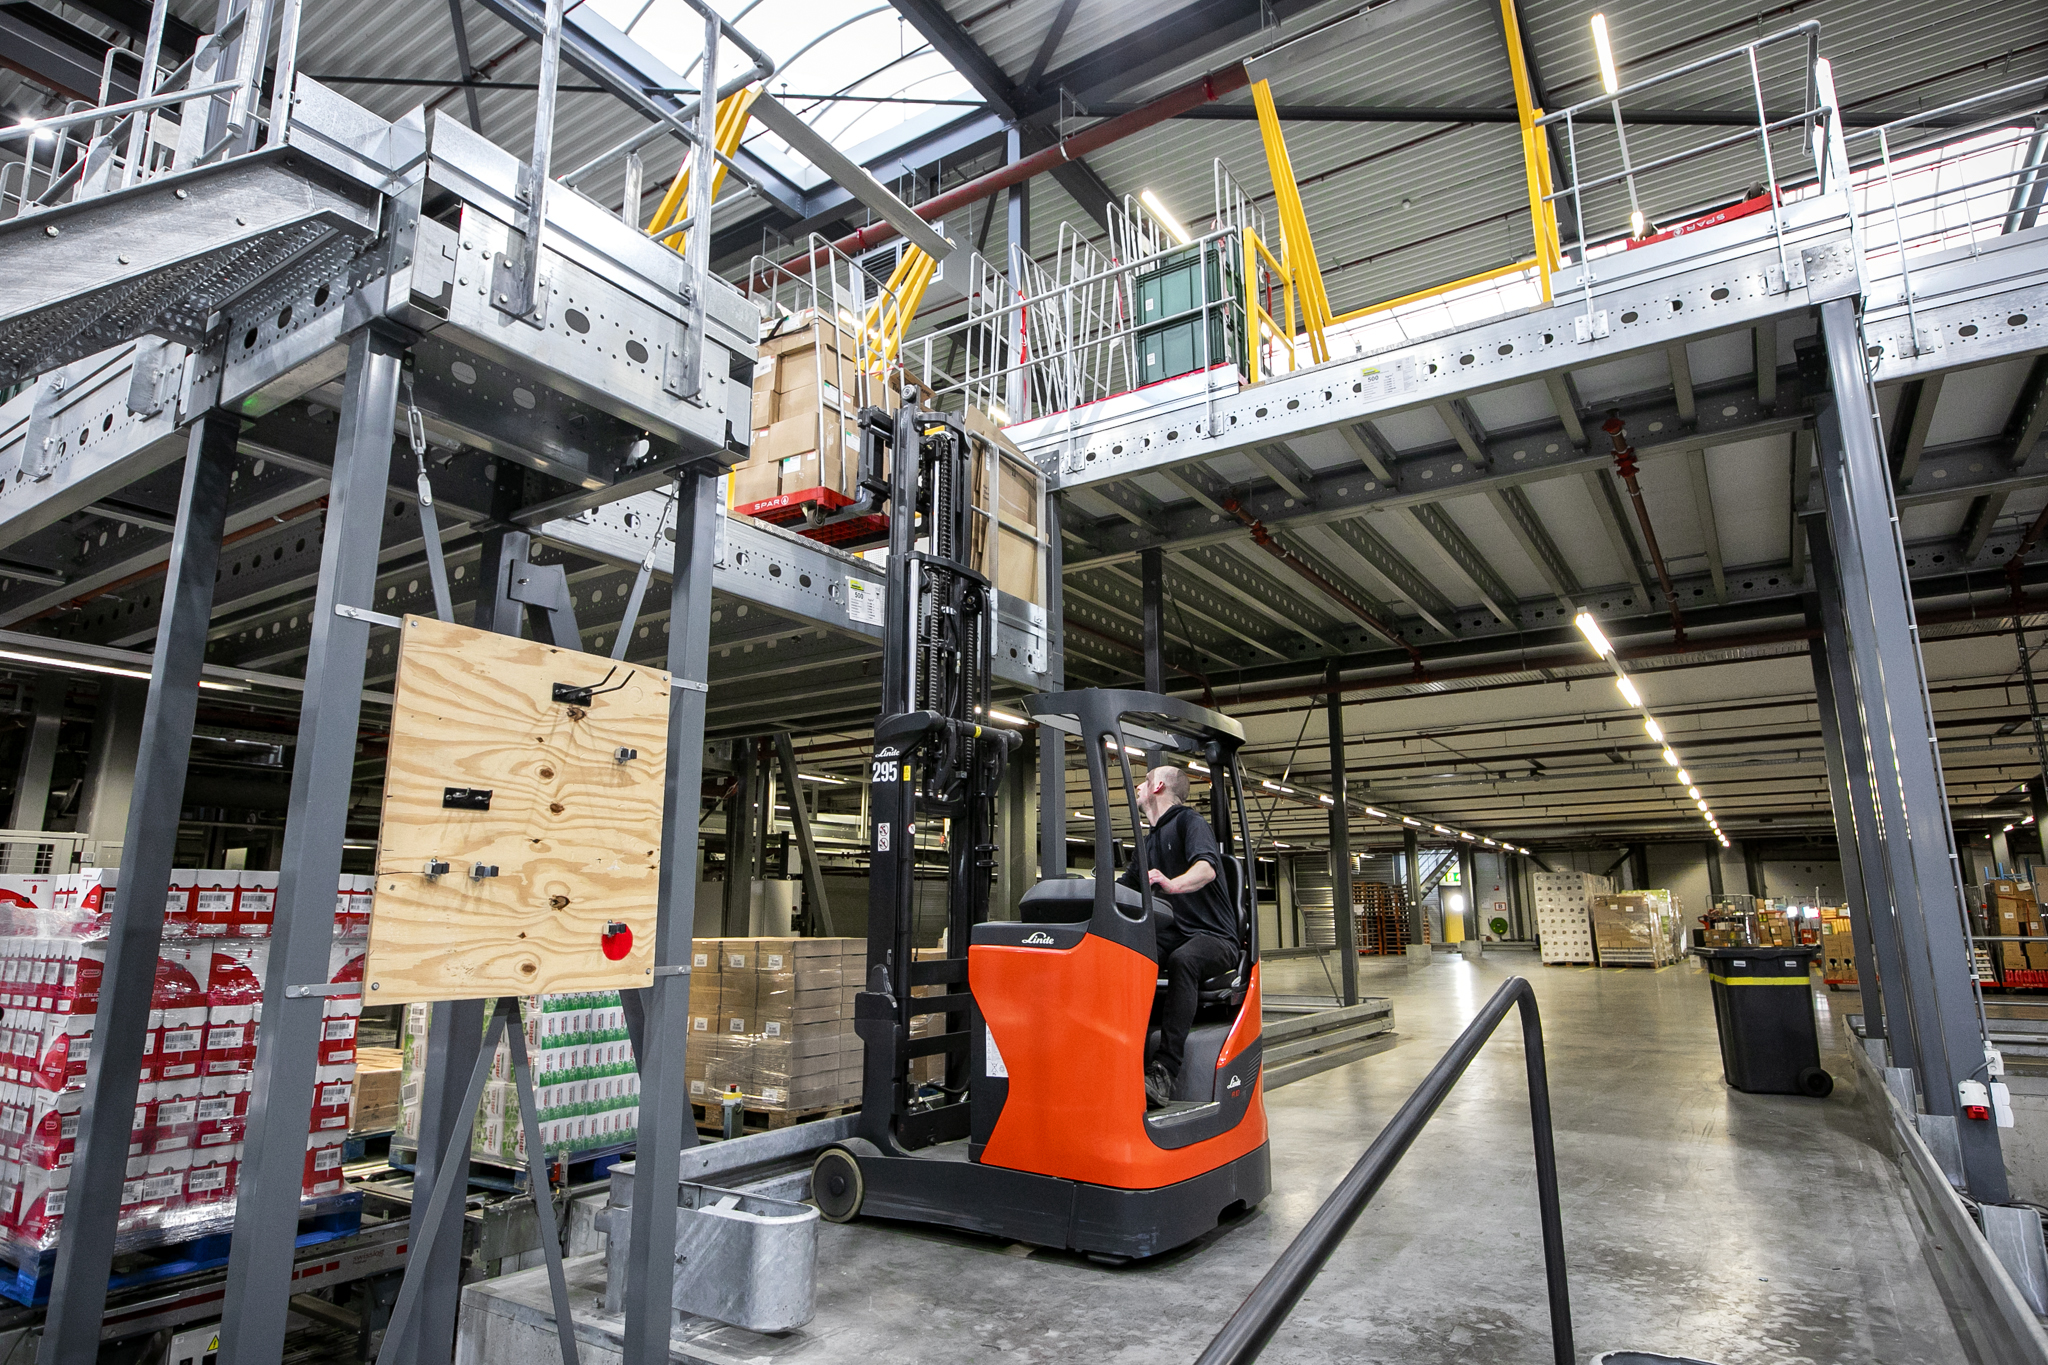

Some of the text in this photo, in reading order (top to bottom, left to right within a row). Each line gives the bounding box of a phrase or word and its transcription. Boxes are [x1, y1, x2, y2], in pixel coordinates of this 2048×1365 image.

[1686, 213, 1726, 232] SPAR
[754, 499, 780, 510] SPAR
[875, 746, 900, 758] Linde
[872, 761, 898, 782] 295
[1022, 932, 1054, 944] Linde
[1227, 1075, 1241, 1089] Linde
